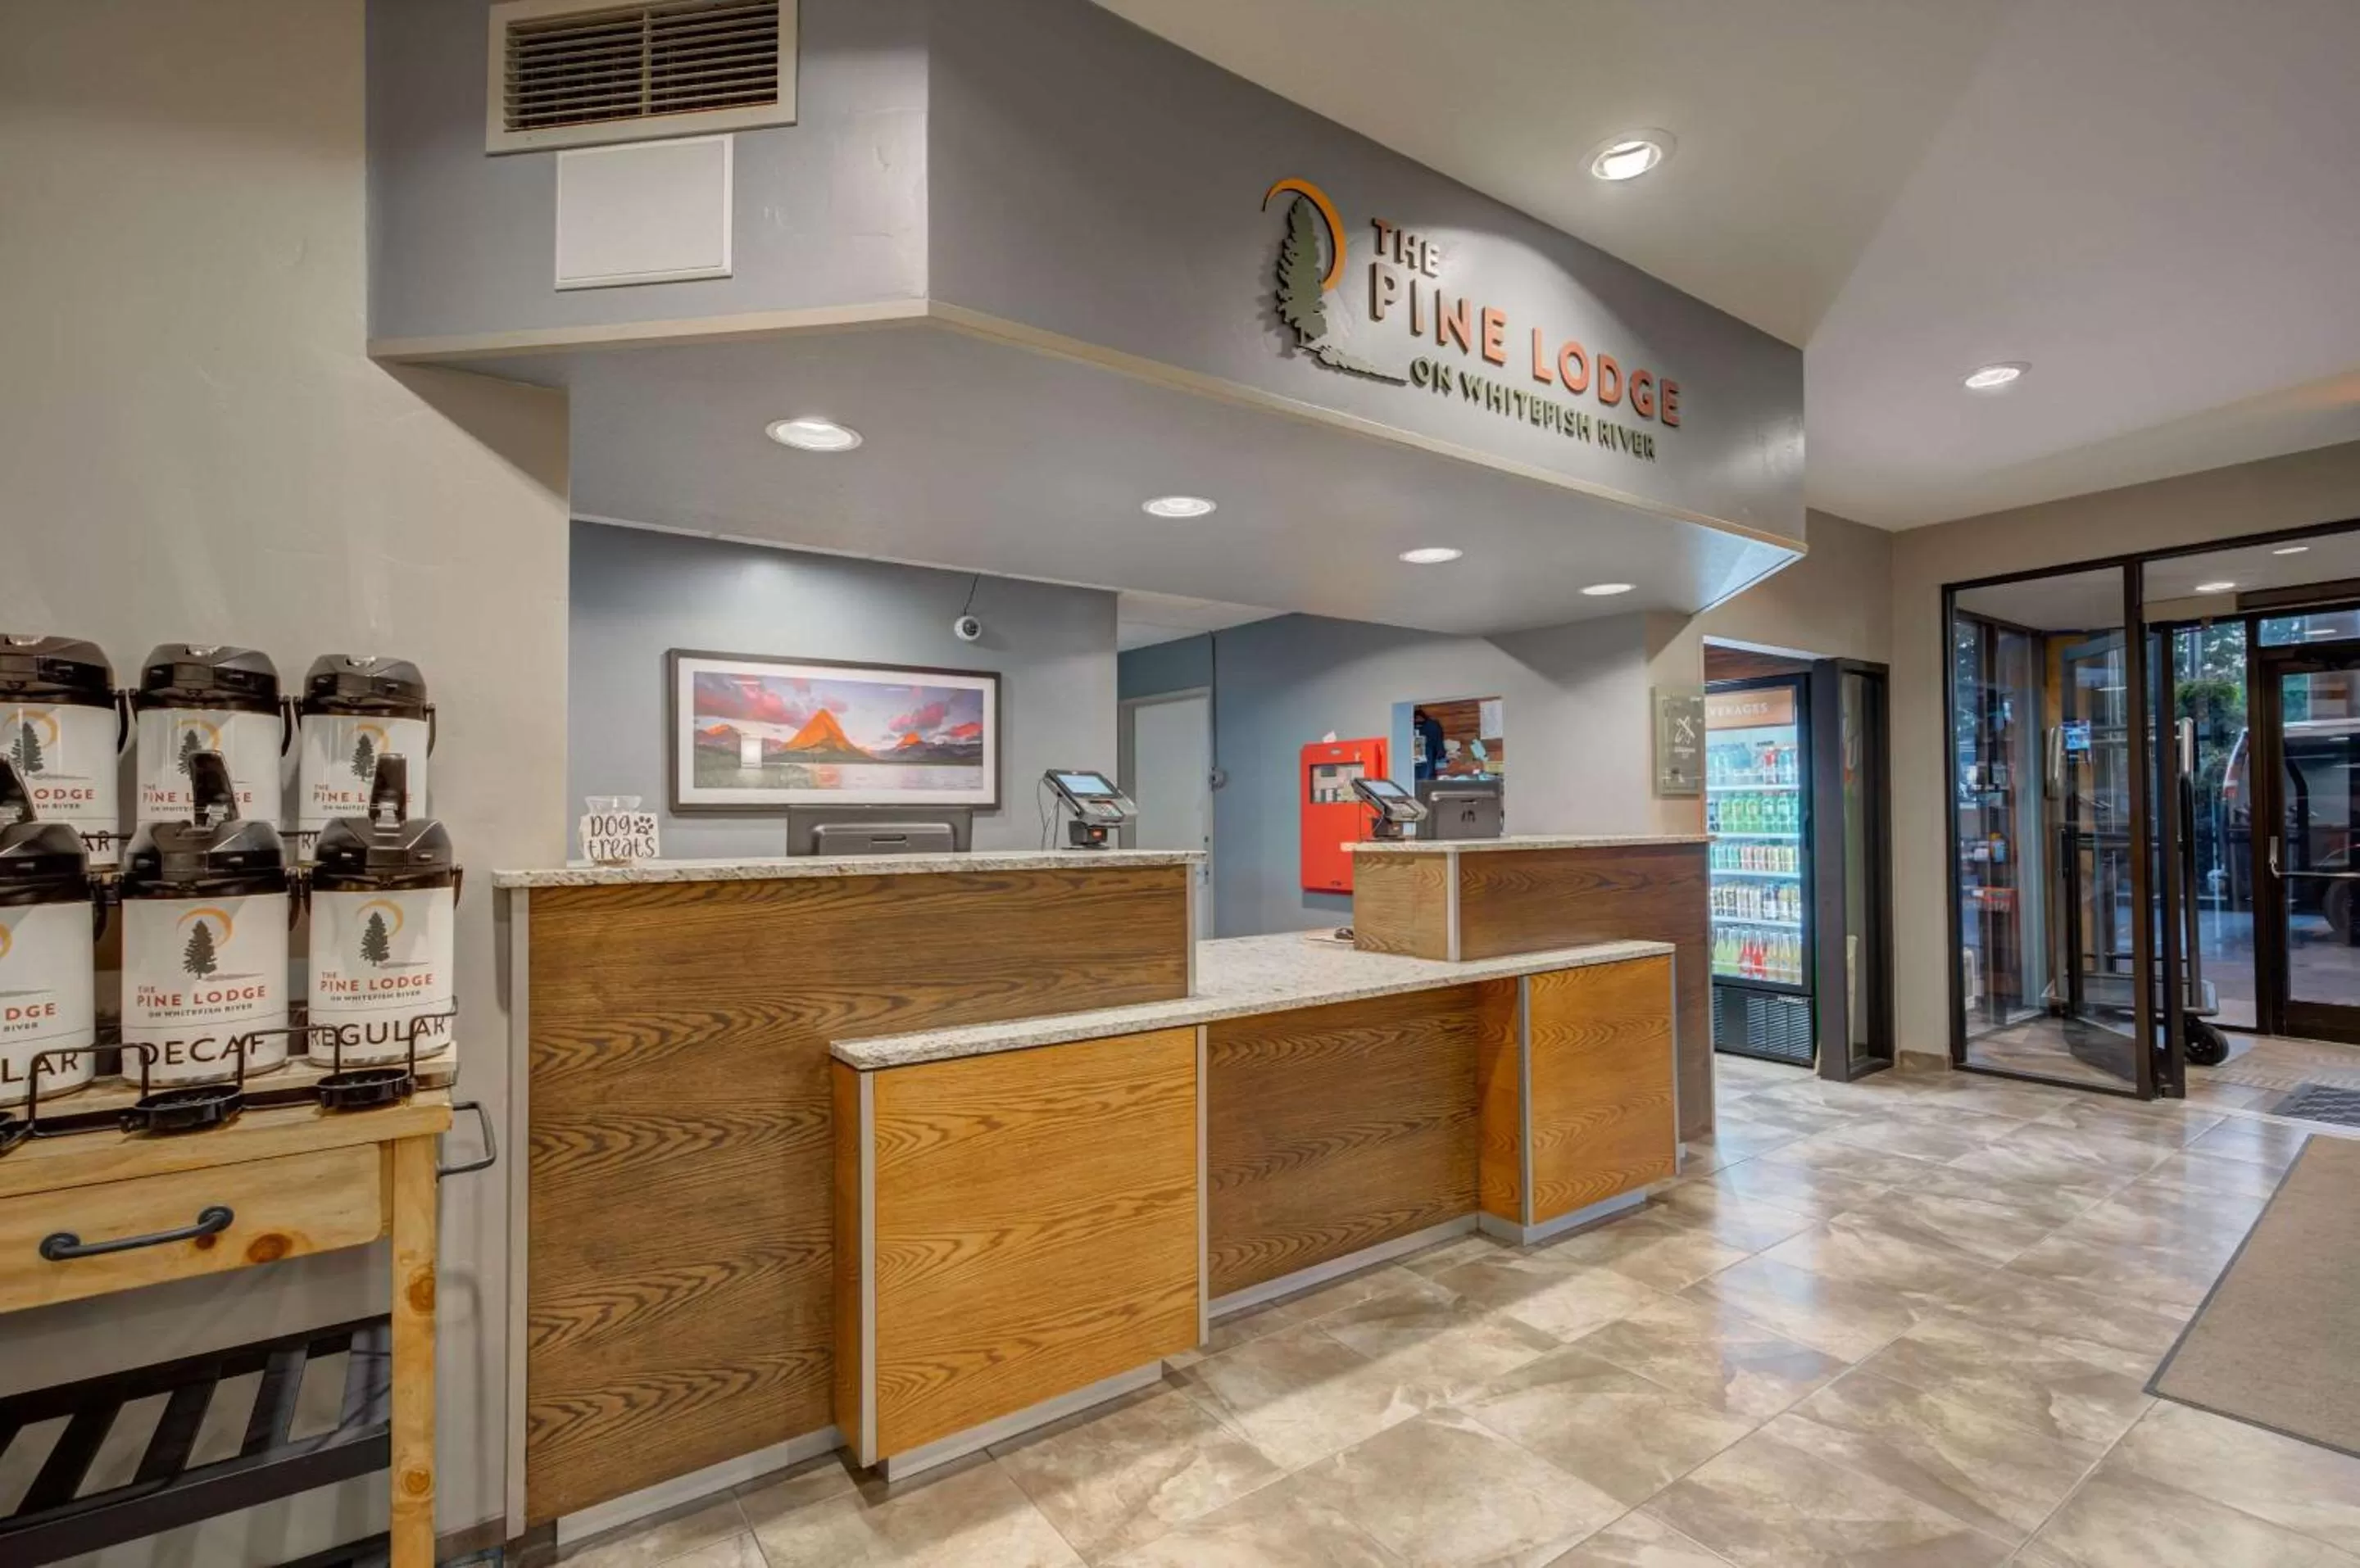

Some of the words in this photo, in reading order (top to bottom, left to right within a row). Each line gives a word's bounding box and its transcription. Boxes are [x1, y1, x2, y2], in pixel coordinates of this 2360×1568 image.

[1371, 217, 1440, 279] THE
[1368, 261, 1508, 368] PINE
[1532, 327, 1680, 428] LODGE
[1409, 356, 1452, 397] ON
[1459, 371, 1592, 443] WHITEFISH
[1597, 418, 1656, 461] RIVER
[1709, 702, 1768, 717] VERAGES
[34, 788, 95, 800] ODGE
[313, 792, 351, 803] PINE
[320, 971, 338, 980] THE
[320, 979, 361, 993] PINE
[369, 972, 434, 991] LODGE
[136, 994, 182, 1008] PINE
[193, 985, 266, 1005] LODGE
[5, 1002, 57, 1022] DGE
[311, 1016, 446, 1047] REGULAR
[140, 1034, 266, 1067] DECAF
